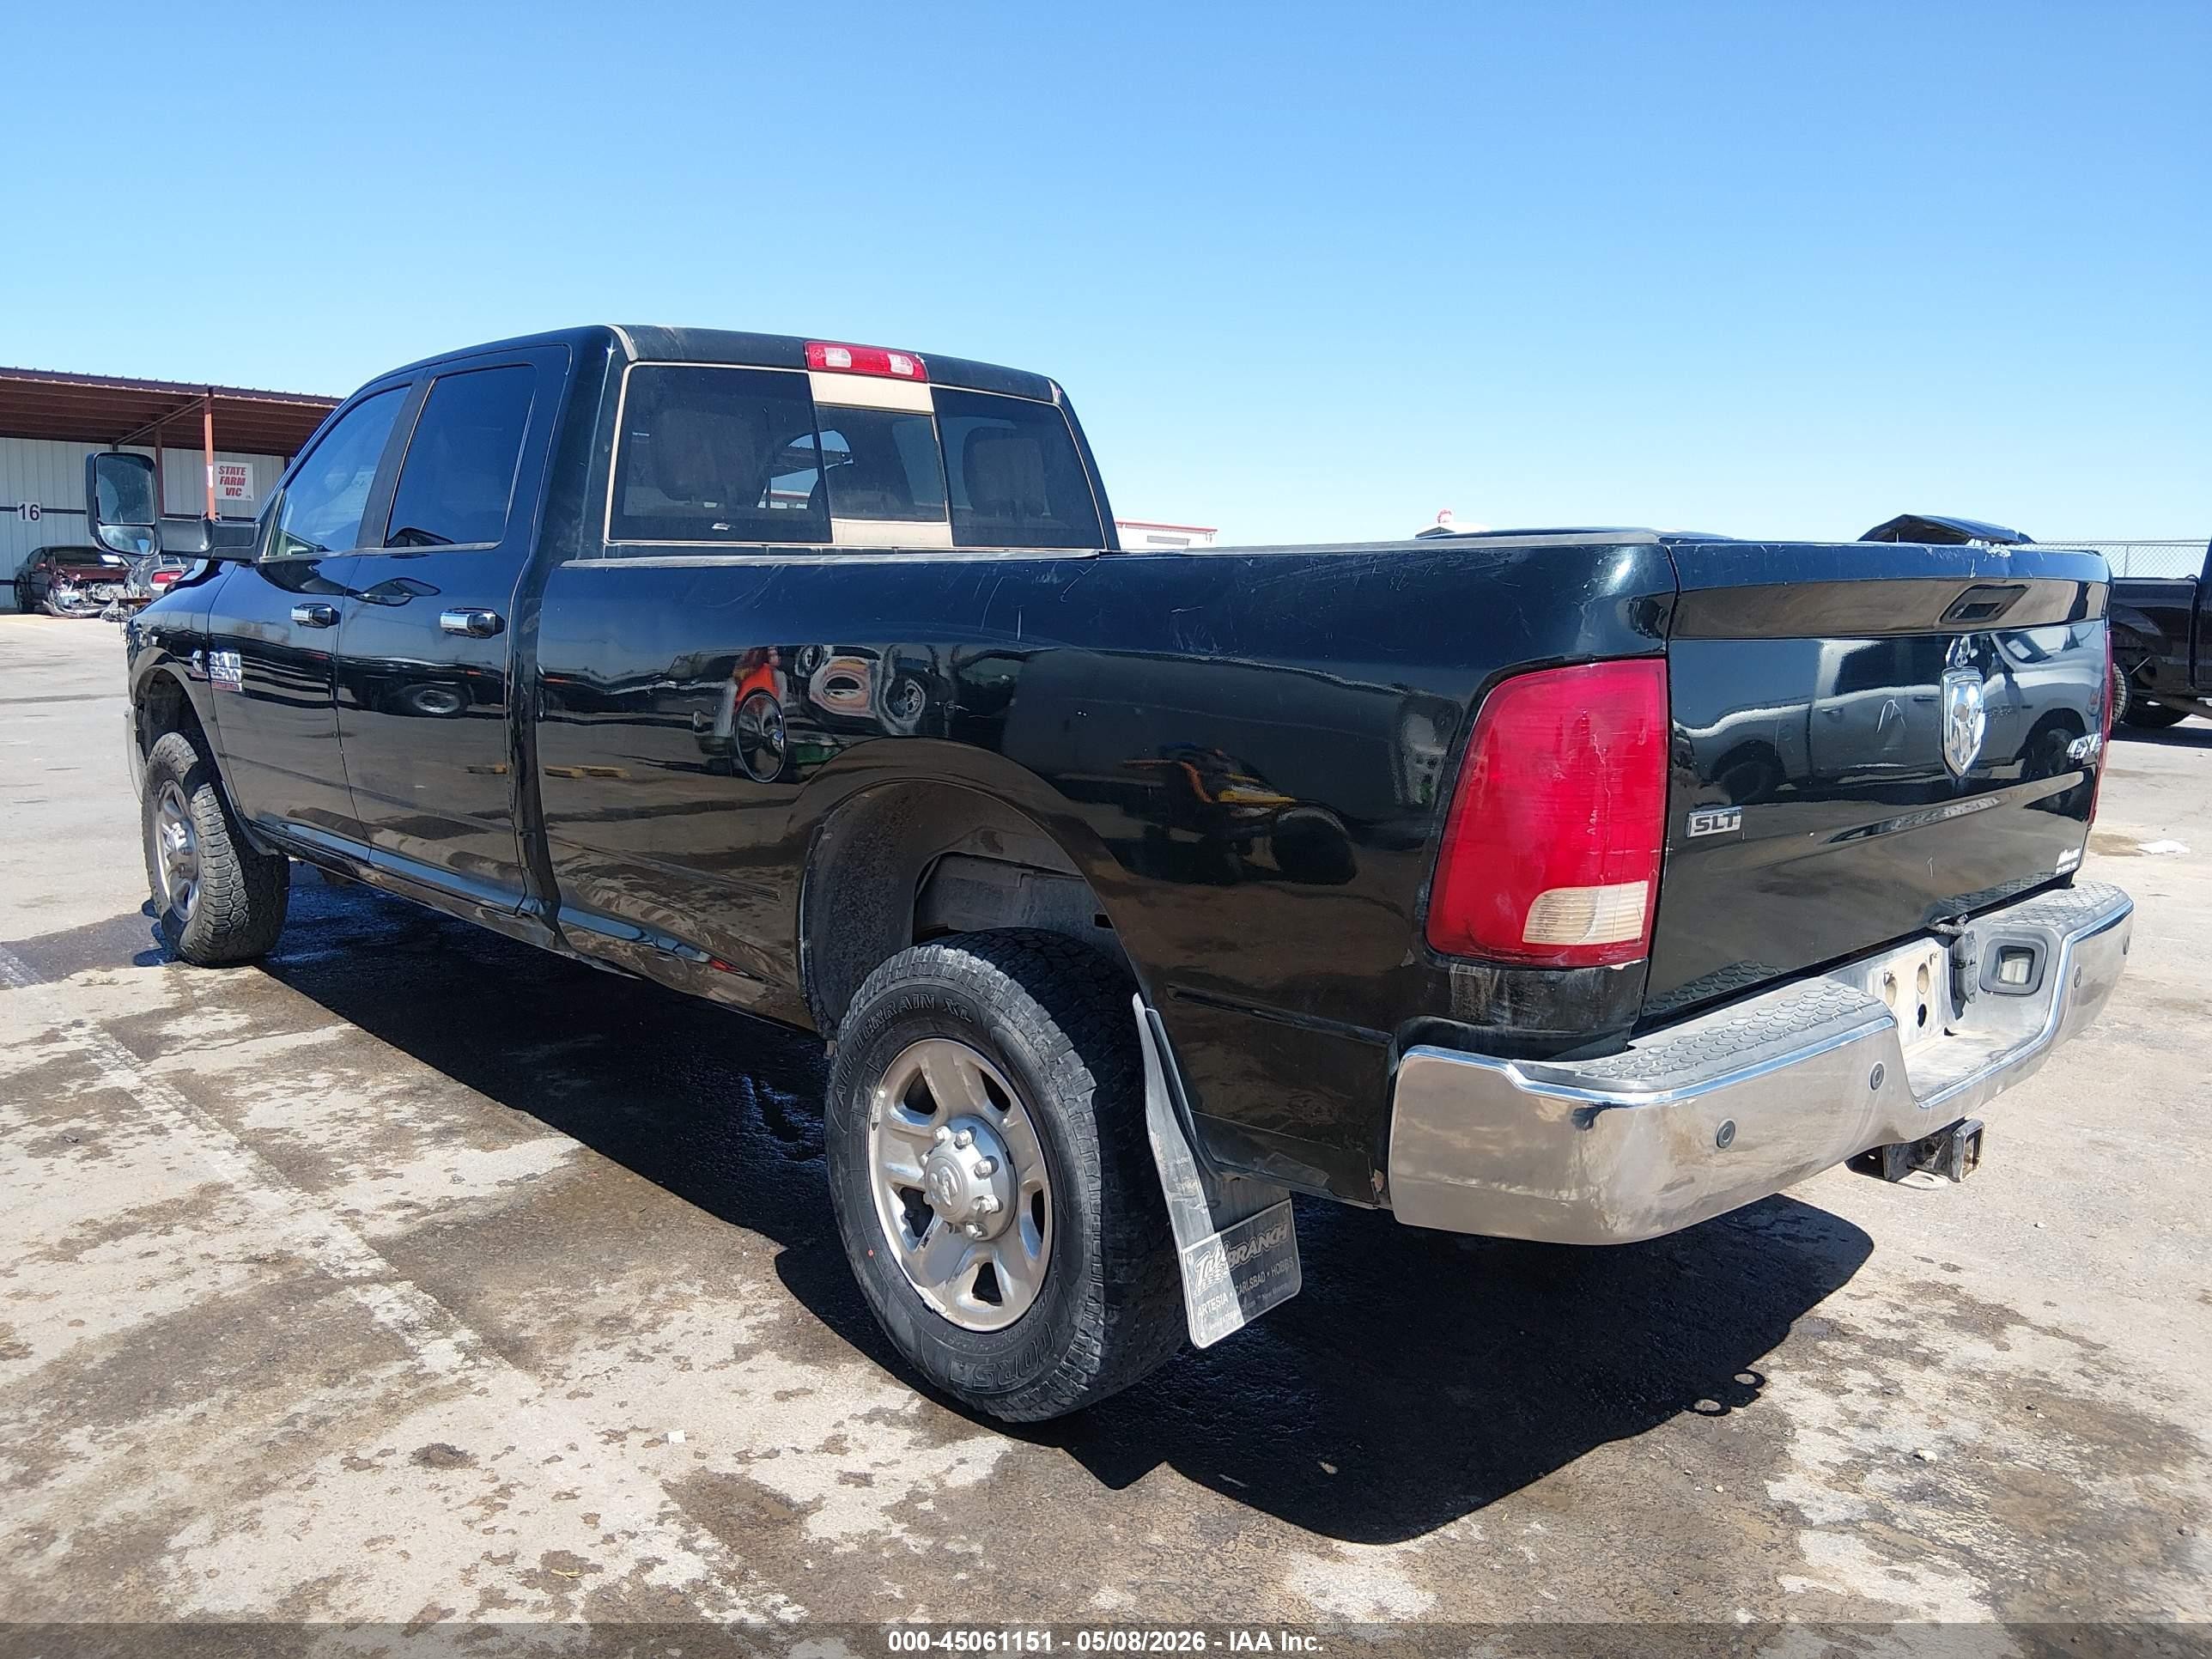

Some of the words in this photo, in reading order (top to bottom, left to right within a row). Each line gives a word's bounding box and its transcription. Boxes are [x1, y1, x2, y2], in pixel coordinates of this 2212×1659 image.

[218, 465, 246, 476] STATE
[219, 476, 246, 486] FARM
[225, 487, 242, 496] VIC
[19, 503, 40, 521] 16
[1694, 812, 1738, 833] SLT
[853, 994, 935, 1049] TERRAIN
[944, 997, 973, 1023] XL
[1227, 1223, 1289, 1268] BRANCH
[1197, 1292, 1229, 1319] ARTESIA
[1271, 1256, 1295, 1278] HOBBS
